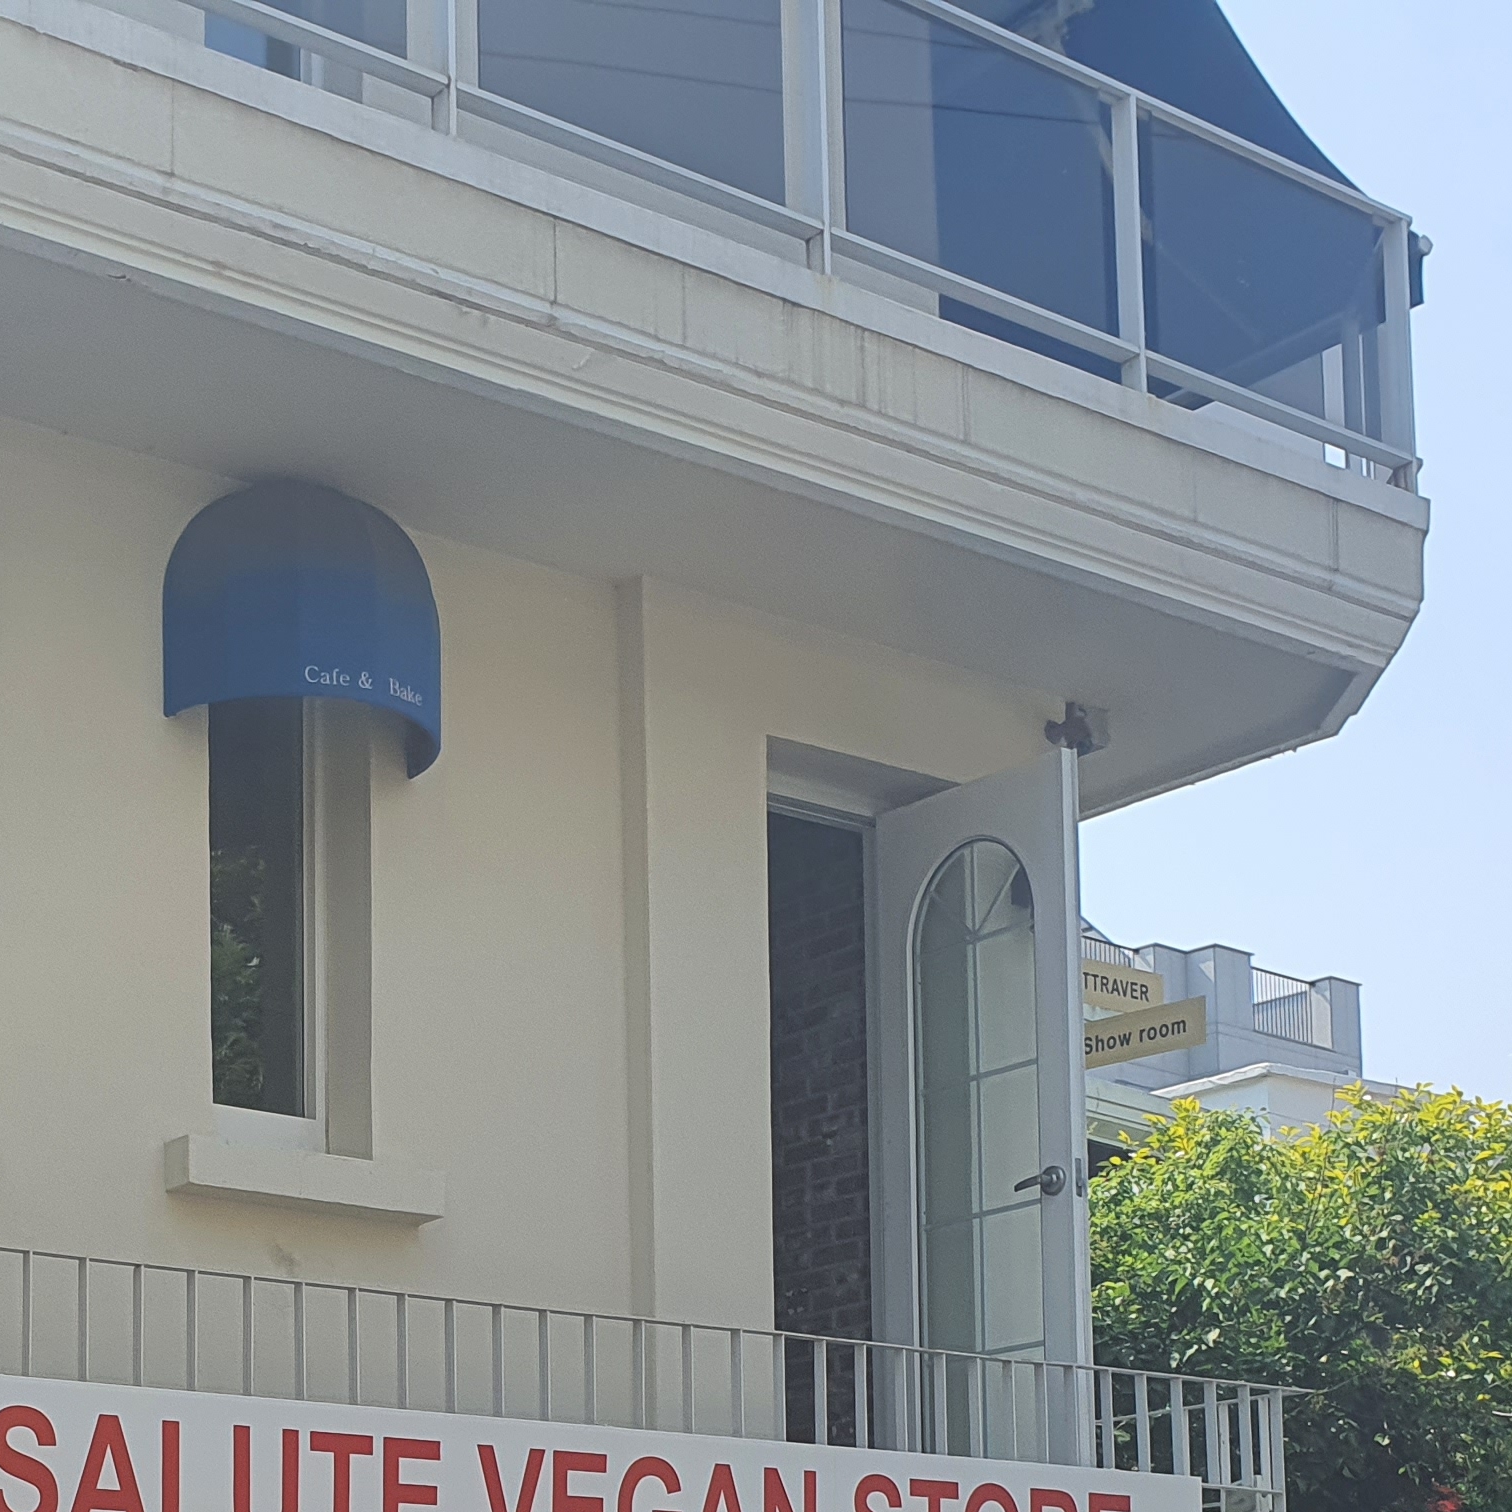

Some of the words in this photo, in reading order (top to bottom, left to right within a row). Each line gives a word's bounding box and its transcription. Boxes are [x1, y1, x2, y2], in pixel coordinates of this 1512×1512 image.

[304, 665, 350, 686] Cafe
[358, 671, 373, 690] &
[389, 677, 423, 706] Bake
[1084, 1031, 1132, 1055] Show
[1139, 1019, 1187, 1043] room
